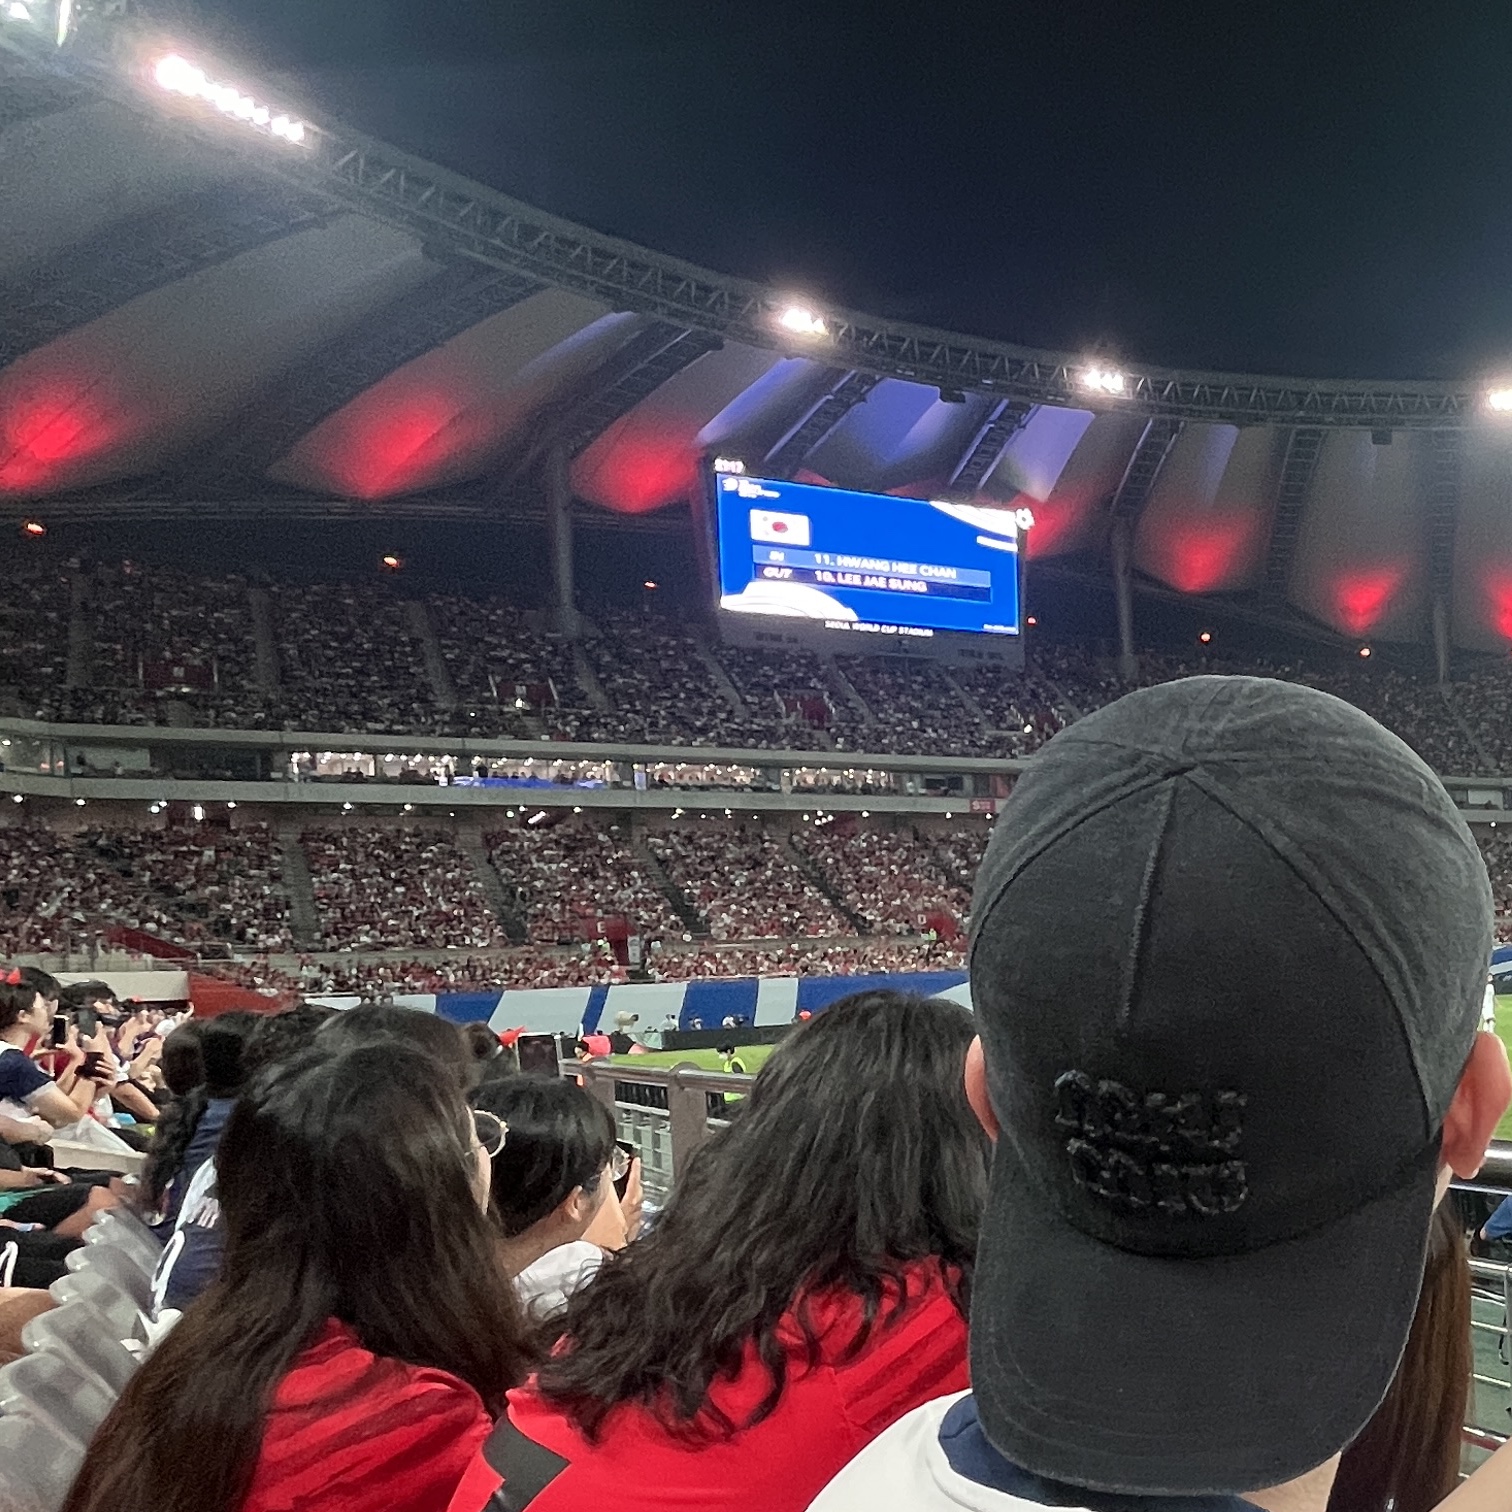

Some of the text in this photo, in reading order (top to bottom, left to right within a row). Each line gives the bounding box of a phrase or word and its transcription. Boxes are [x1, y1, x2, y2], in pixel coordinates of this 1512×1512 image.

[769, 550, 784, 562] IN
[763, 567, 793, 579] OUT
[815, 553, 957, 579] 11. HWANG HEE CHAN
[815, 570, 928, 592] 10. LEE JAE SUNG
[852, 622, 880, 633] WORLD
[881, 624, 898, 635] CUP
[898, 626, 935, 637] STADIUM
